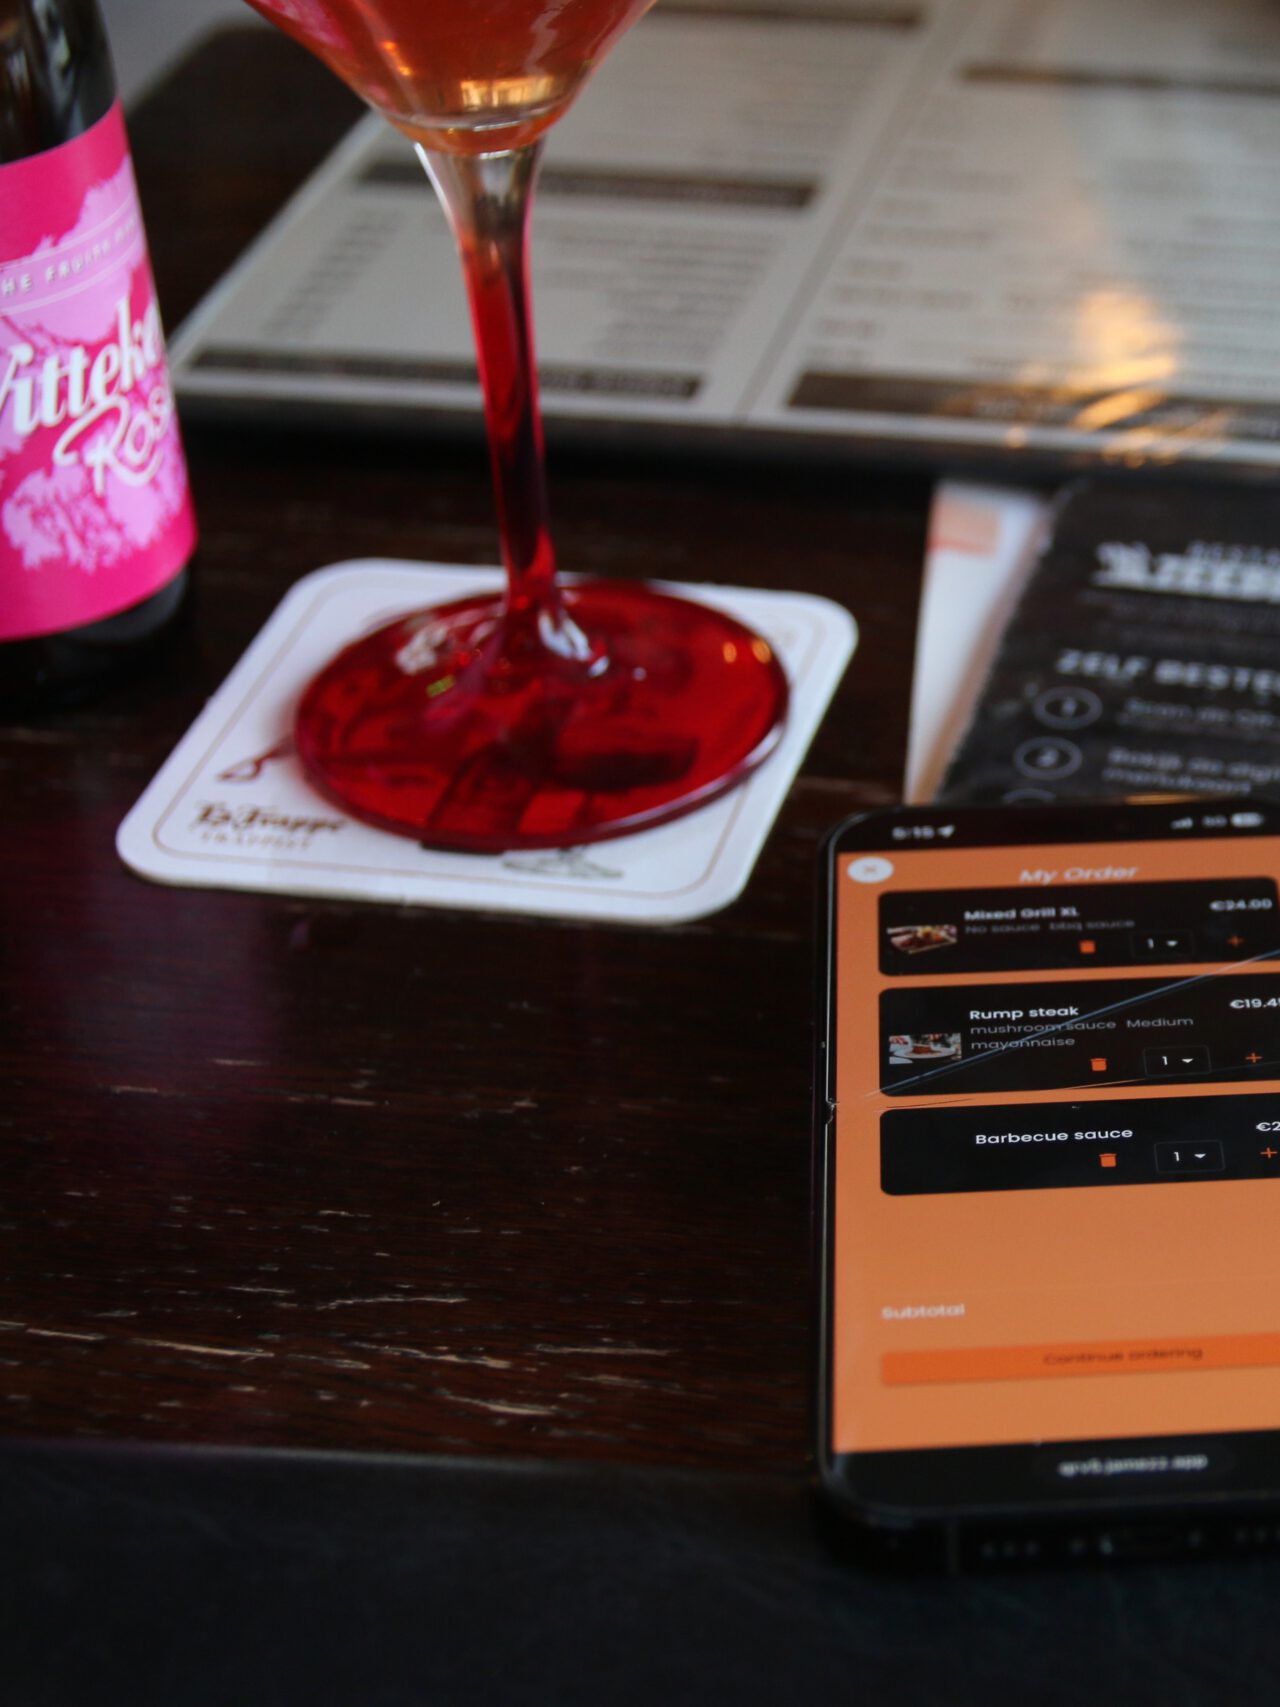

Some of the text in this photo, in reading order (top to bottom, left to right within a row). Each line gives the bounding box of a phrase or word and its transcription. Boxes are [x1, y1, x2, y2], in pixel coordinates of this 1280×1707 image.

[2, 273, 33, 297] HE
[1020, 865, 1139, 885] My Order
[964, 908, 1017, 921] Mixed
[1020, 905, 1057, 919] Grill
[969, 1006, 1080, 1021] Rump steak
[970, 1017, 1194, 1035] mushroom sauce Medium
[971, 1036, 1076, 1051] mayonnaise
[975, 1129, 1133, 1145] Barbecue sauce
[881, 1303, 965, 1320] Subtotal
[1044, 1348, 1203, 1365] Continue ordering
